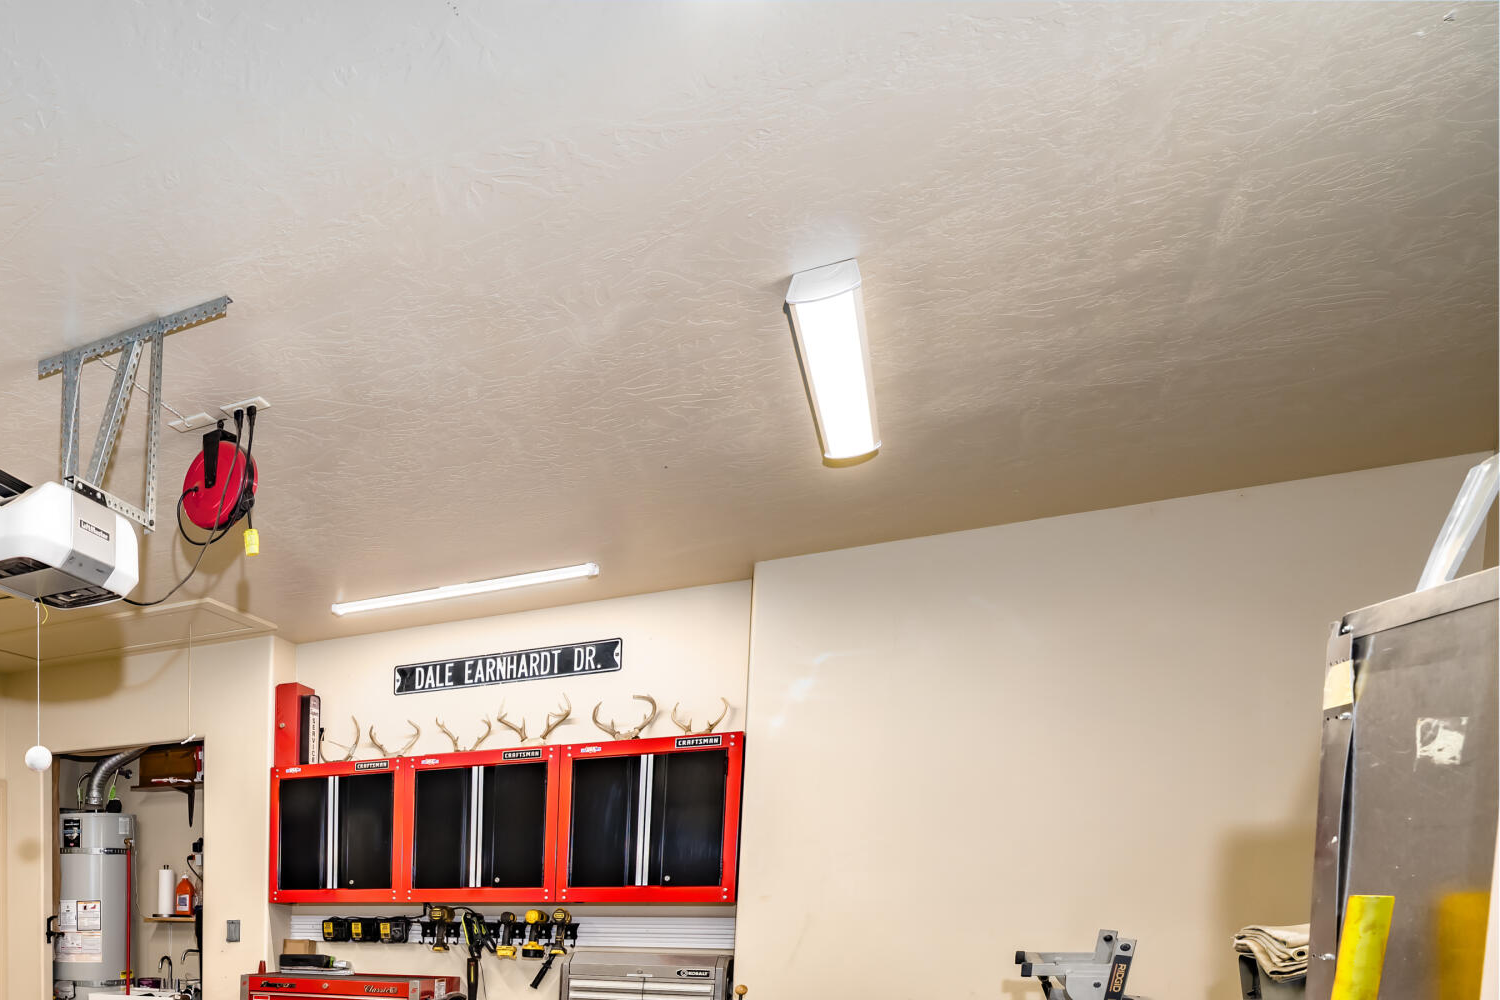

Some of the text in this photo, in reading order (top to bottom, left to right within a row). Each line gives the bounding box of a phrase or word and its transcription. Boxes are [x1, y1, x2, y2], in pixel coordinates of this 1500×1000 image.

[414, 646, 602, 690] DALE EARNHARDT DR.
[677, 737, 719, 747] CRAFTSMAN
[504, 750, 540, 760] CRAFTSMAN
[356, 760, 388, 771] CRAFTSMAN
[1113, 964, 1126, 992] RIDGID
